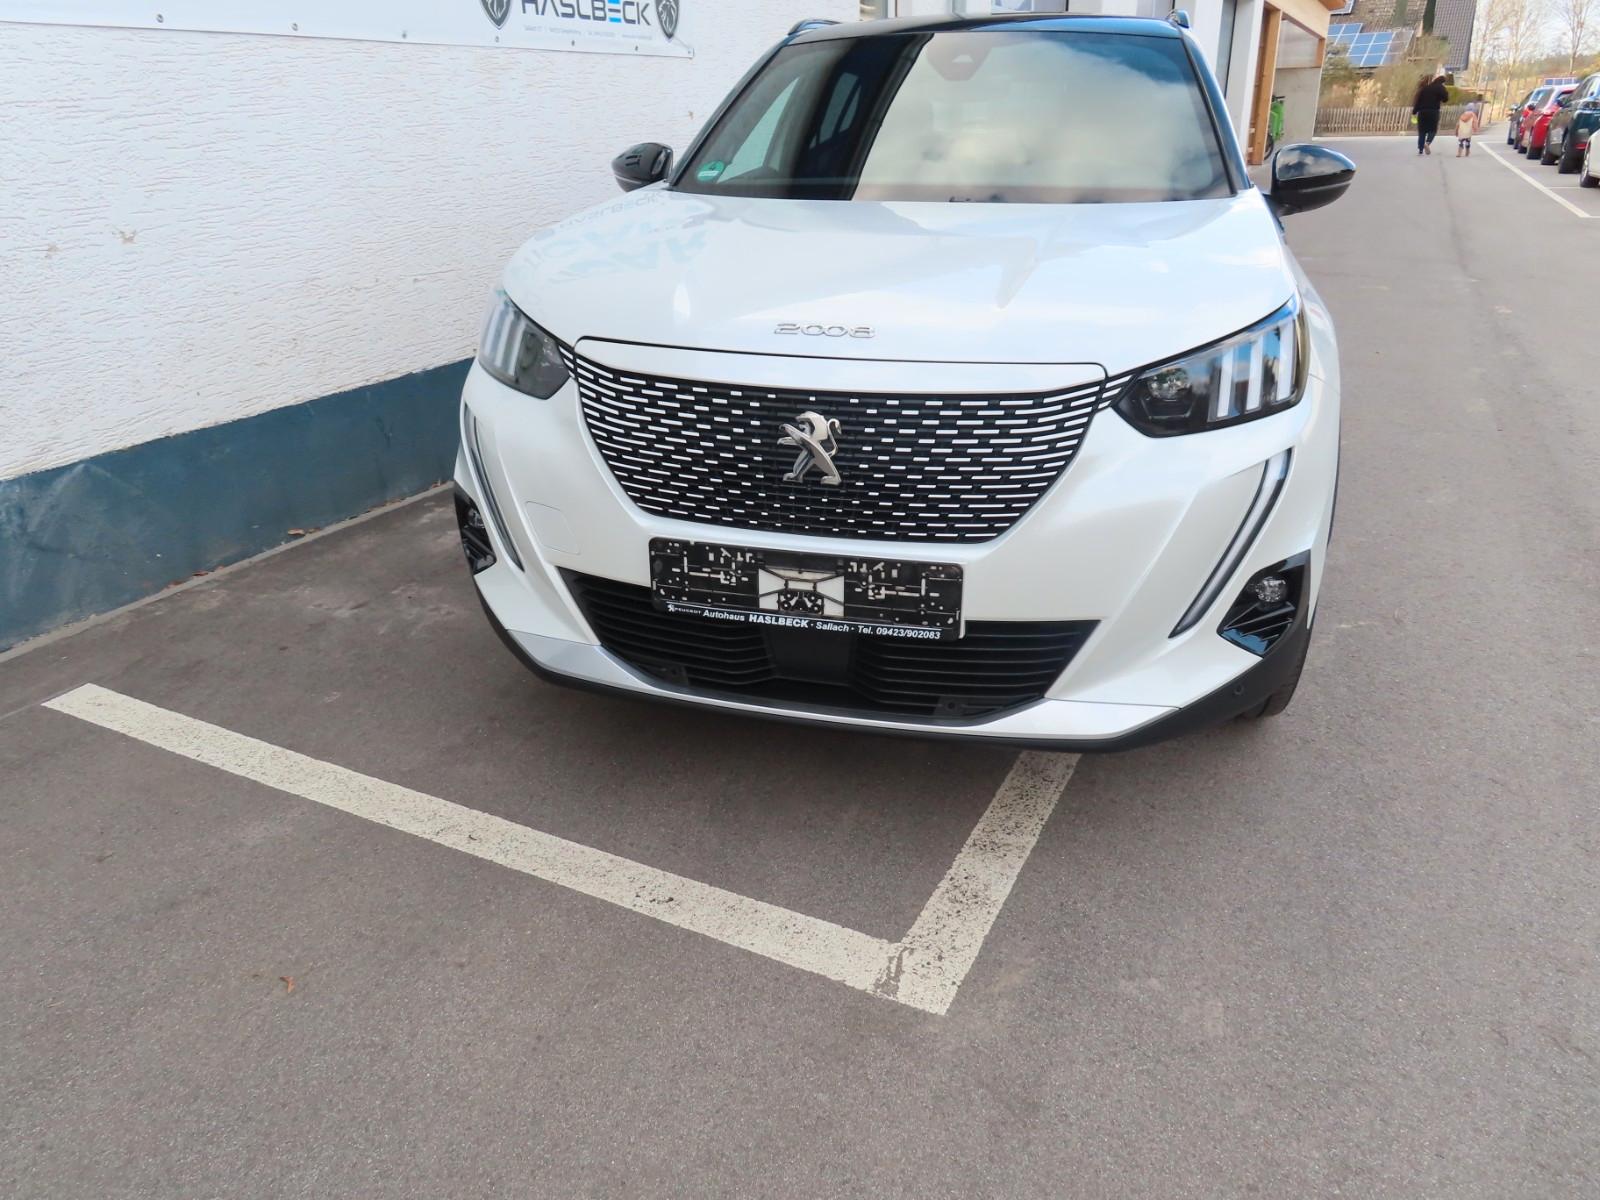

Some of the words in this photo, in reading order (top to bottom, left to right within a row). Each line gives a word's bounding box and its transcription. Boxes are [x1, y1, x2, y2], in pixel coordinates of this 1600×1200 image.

[521, 0, 651, 26] HASLBECK
[774, 322, 876, 339] 2008
[702, 609, 745, 622] Autohaus
[749, 613, 809, 628] HASLBECK
[815, 621, 850, 633] Sallach
[857, 625, 874, 635] Tel.
[876, 627, 941, 640] 09423/902083
